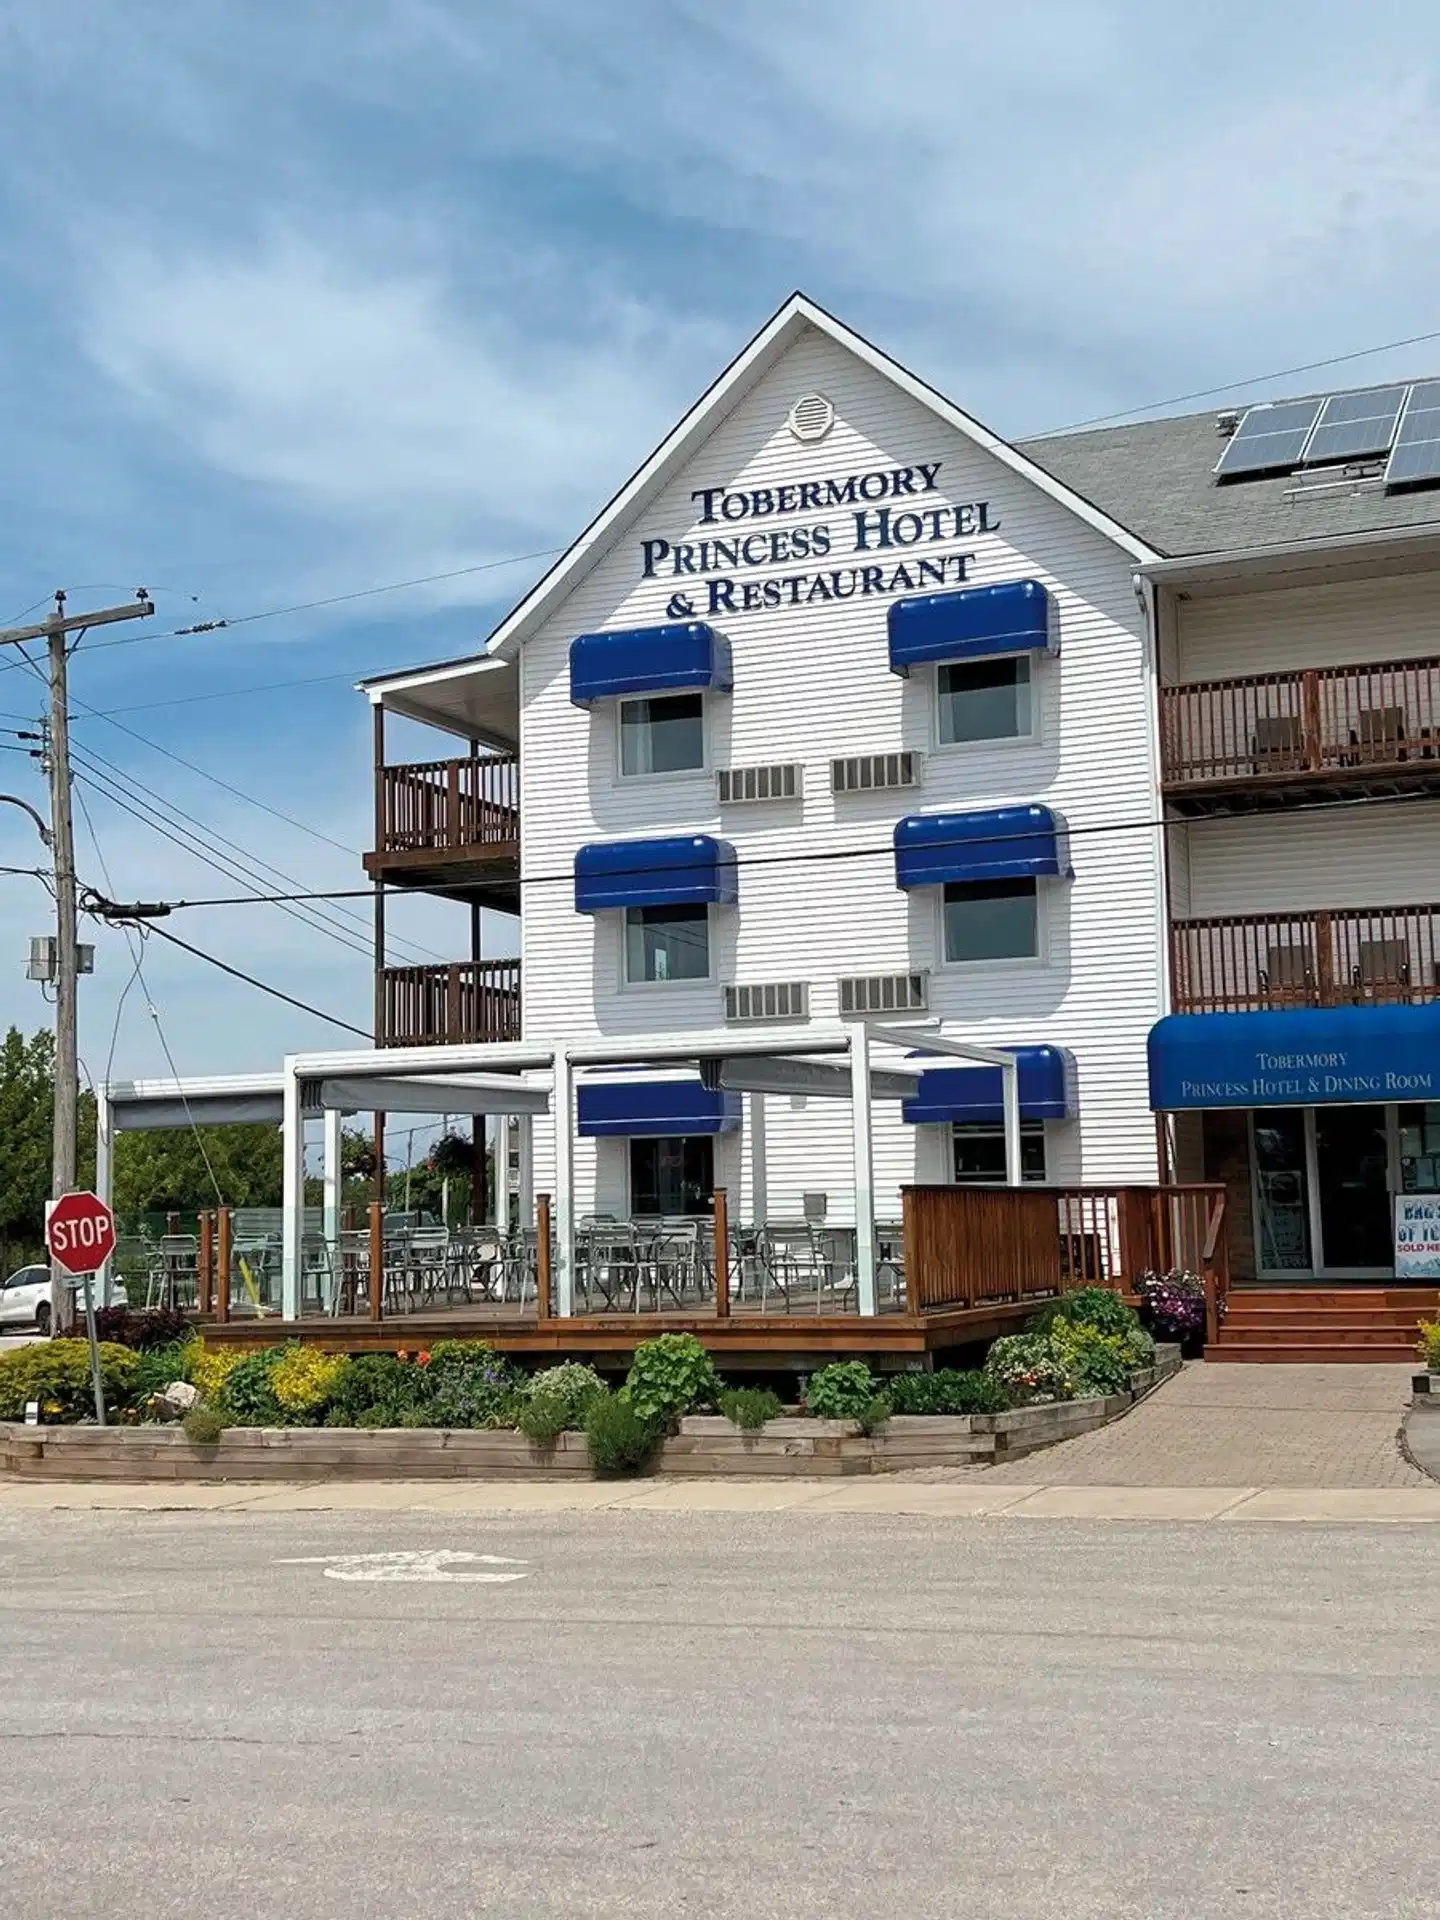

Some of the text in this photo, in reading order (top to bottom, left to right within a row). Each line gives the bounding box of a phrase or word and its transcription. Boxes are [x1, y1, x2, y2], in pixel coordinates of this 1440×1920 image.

[691, 462, 942, 526] TOBERMORY
[640, 502, 1001, 578] PRINCESS HOTEL
[666, 554, 976, 618] & RESTAURANT
[1256, 1053, 1348, 1070] TOBERMORY
[1181, 1072, 1432, 1098] PRINCESS HOTEL & DINING ROOM
[53, 1216, 109, 1250] STOP
[1397, 1243, 1425, 1252] SOLD
